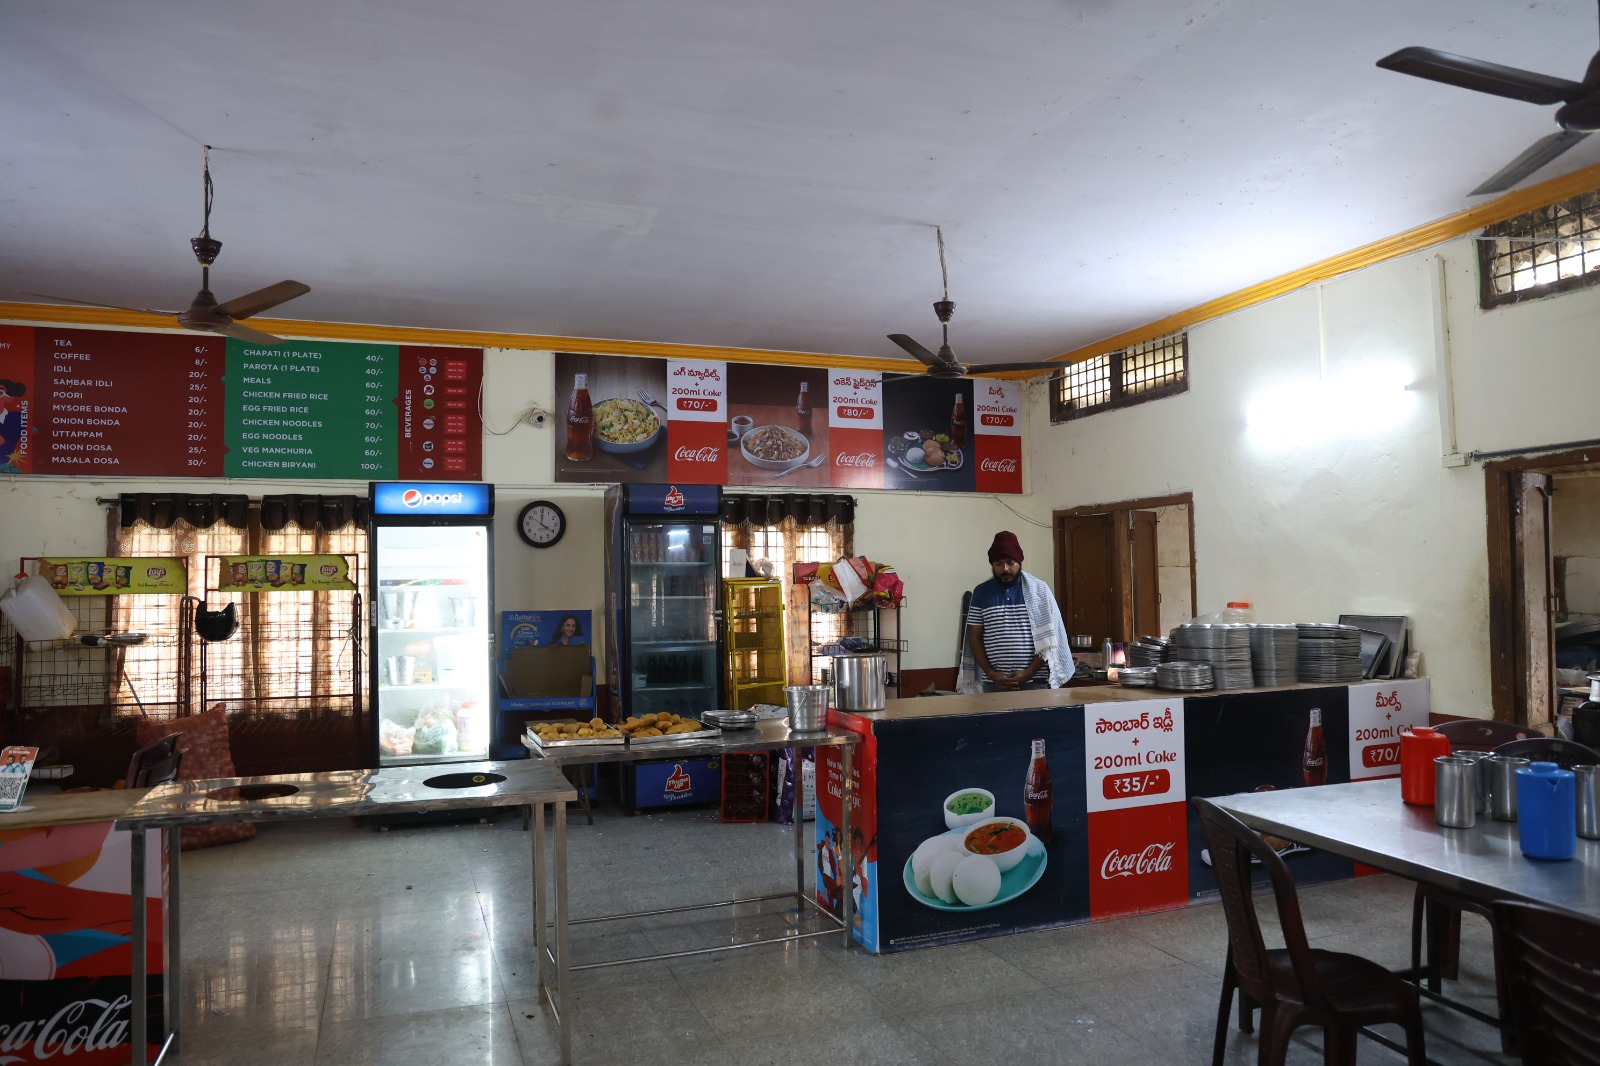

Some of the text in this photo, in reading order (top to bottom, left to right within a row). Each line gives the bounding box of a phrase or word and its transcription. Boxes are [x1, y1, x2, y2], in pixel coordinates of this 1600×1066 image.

[675, 446, 720, 462] Coca-Cola
[836, 452, 876, 467] Coca-Cola
[981, 458, 1016, 472] Coca-Cola
[1095, 713, 1149, 735] సాంబార్
[1356, 726, 1393, 741] 200ml
[1094, 750, 1177, 770] 200ml Coke
[1101, 842, 1175, 880] Coca-Cola
